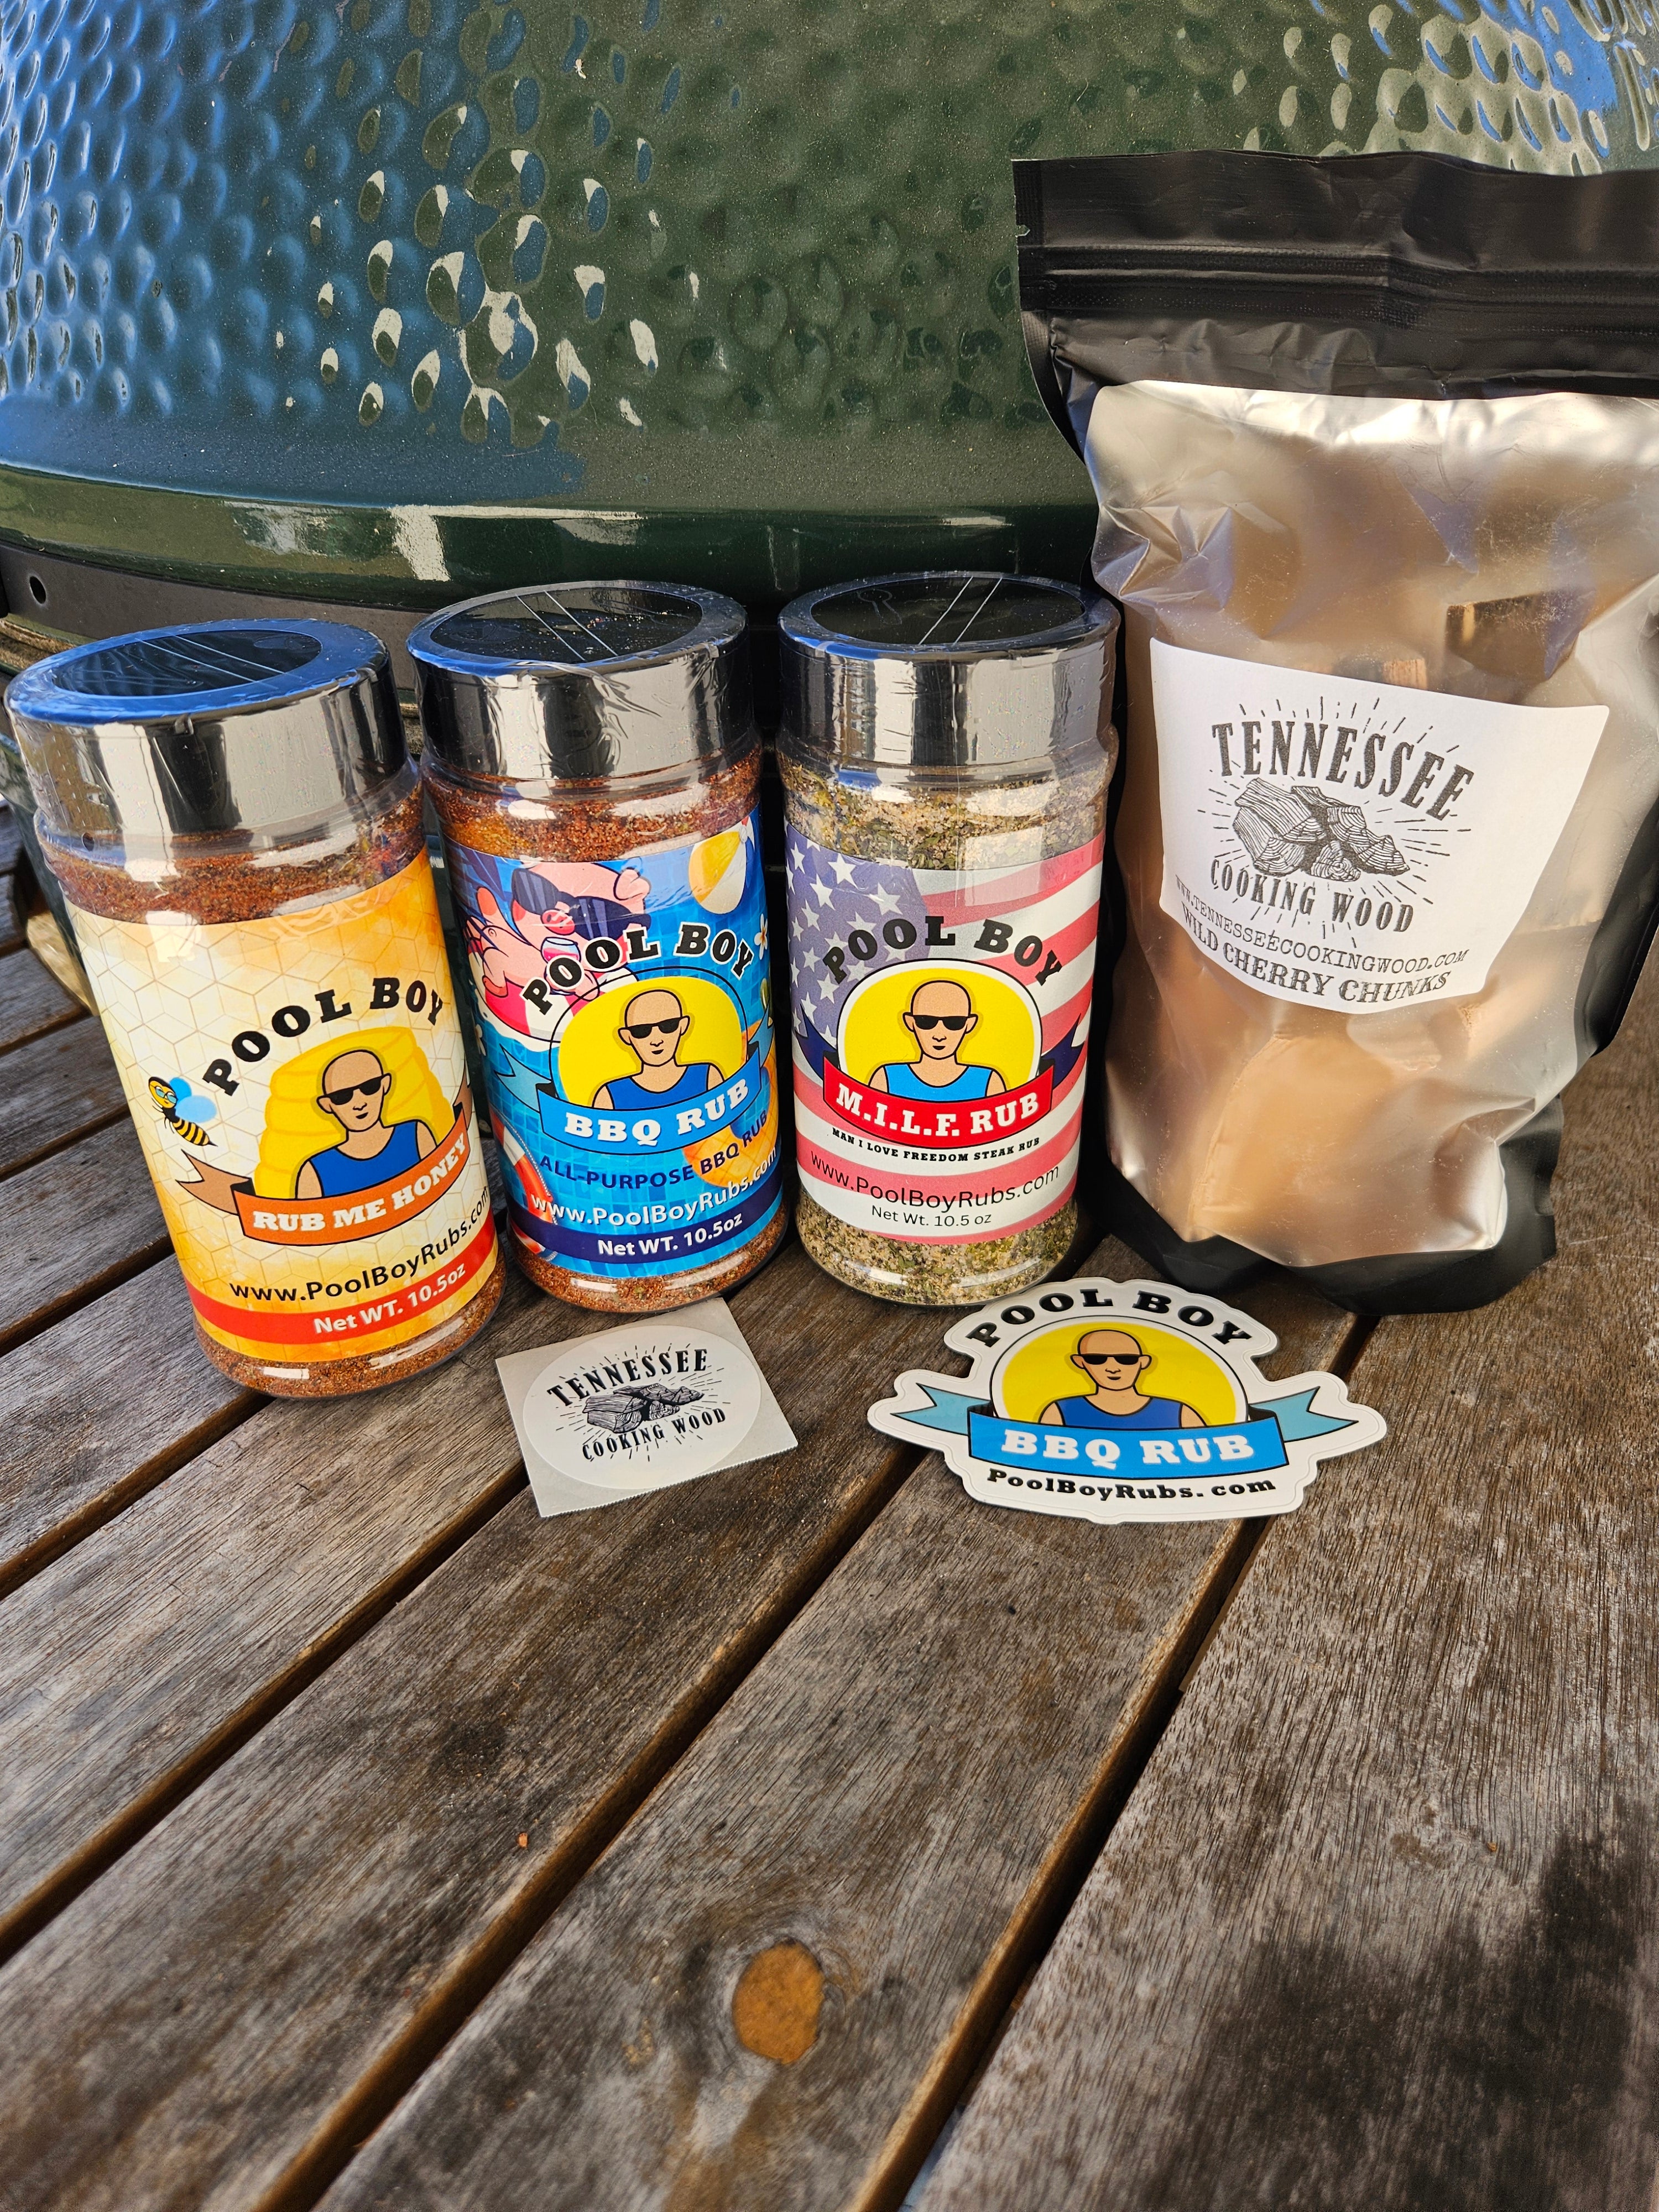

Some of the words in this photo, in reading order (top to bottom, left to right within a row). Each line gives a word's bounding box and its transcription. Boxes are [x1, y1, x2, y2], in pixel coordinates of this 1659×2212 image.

[1212, 720, 1475, 821] TENNESSEE
[1176, 874, 1468, 974] WWW.TENNESSEECOOKINGWOOD.COM
[1210, 859, 1316, 917] COOKING
[1332, 891, 1414, 933] WOOD
[521, 926, 660, 1016] POOL
[676, 922, 755, 980] BOY
[823, 916, 956, 984] POOL
[974, 919, 1063, 986] BOY
[1181, 901, 1218, 952] WILD
[1223, 942, 1334, 997] CHERRY
[1339, 971, 1451, 1004] CHUNKS
[202, 989, 352, 1095] POOL
[369, 977, 444, 1026] BOY
[565, 1111, 662, 1146] BBQ
[676, 1077, 750, 1136] RUB
[832, 1126, 854, 1146] MAN
[858, 1137, 864, 1148] I
[867, 1140, 900, 1159] LOVE
[903, 1150, 969, 1162] FREEDOM
[973, 1145, 1016, 1161] STEAK
[1019, 1136, 1040, 1152] RUB
[836, 1082, 961, 1138] M.I.L.F.
[970, 1092, 1040, 1135] RUB
[252, 1210, 326, 1232] RUB
[333, 1198, 387, 1229] ME
[392, 1132, 467, 1210] HONEY
[540, 1155, 695, 1191] ALL-PURPOSE
[700, 1142, 739, 1175] BBQ
[742, 1109, 767, 1148] RUB
[810, 1149, 1060, 1214] www.PoolBoyRubs.com
[530, 1146, 776, 1228] www.PoolBoyRubs.com
[871, 1204, 899, 1224] Net
[902, 1212, 930, 1227] Wt.
[933, 1213, 969, 1228] 10.5
[973, 1213, 992, 1224] oz
[228, 1186, 488, 1302] www.PoolBoyRubs.com
[597, 1239, 635, 1256] Net
[638, 1235, 679, 1255] WT.
[682, 1215, 743, 1248] 10.5oz
[313, 1313, 358, 1335] Net
[359, 1297, 403, 1325] WT.
[406, 1264, 466, 1308] 10.5oz
[964, 1288, 1114, 1348] POOL
[1131, 1290, 1253, 1348] BOY
[547, 1348, 708, 1406] TENNESSEE
[582, 1424, 664, 1461] COOKING
[671, 1407, 726, 1434] WOOD
[1001, 1429, 1121, 1470] BBQ
[1139, 1434, 1255, 1464] RUB
